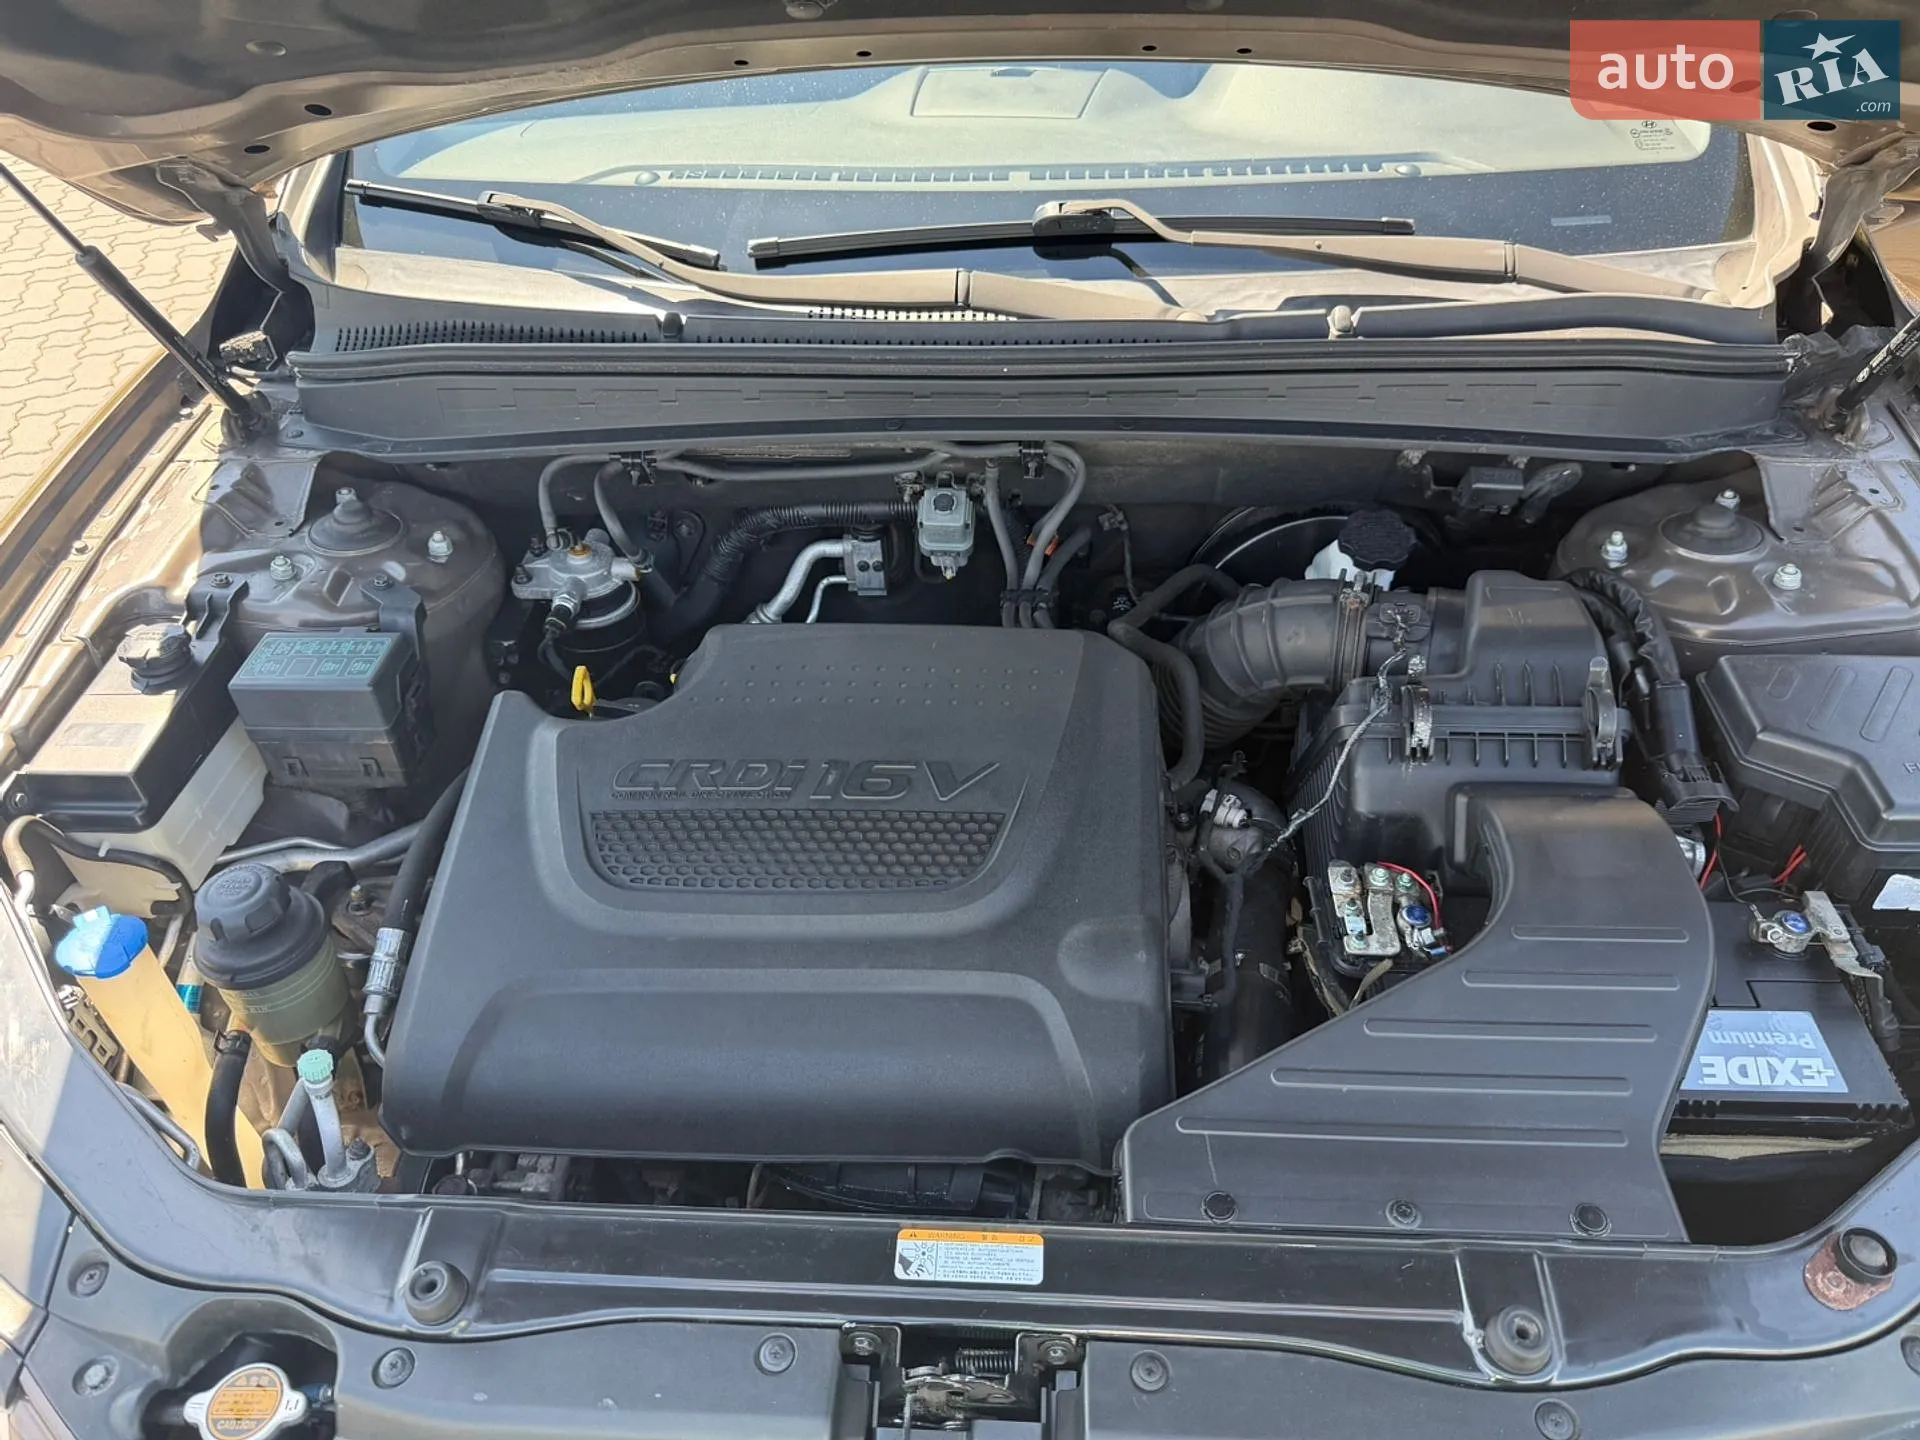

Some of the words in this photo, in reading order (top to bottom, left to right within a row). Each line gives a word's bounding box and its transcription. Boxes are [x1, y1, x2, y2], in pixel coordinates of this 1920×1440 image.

[612, 759, 808, 792] CRDi
[810, 759, 1000, 801] 16V
[1708, 1030, 1816, 1050] Premium
[1700, 1056, 1834, 1087] EXIDE
